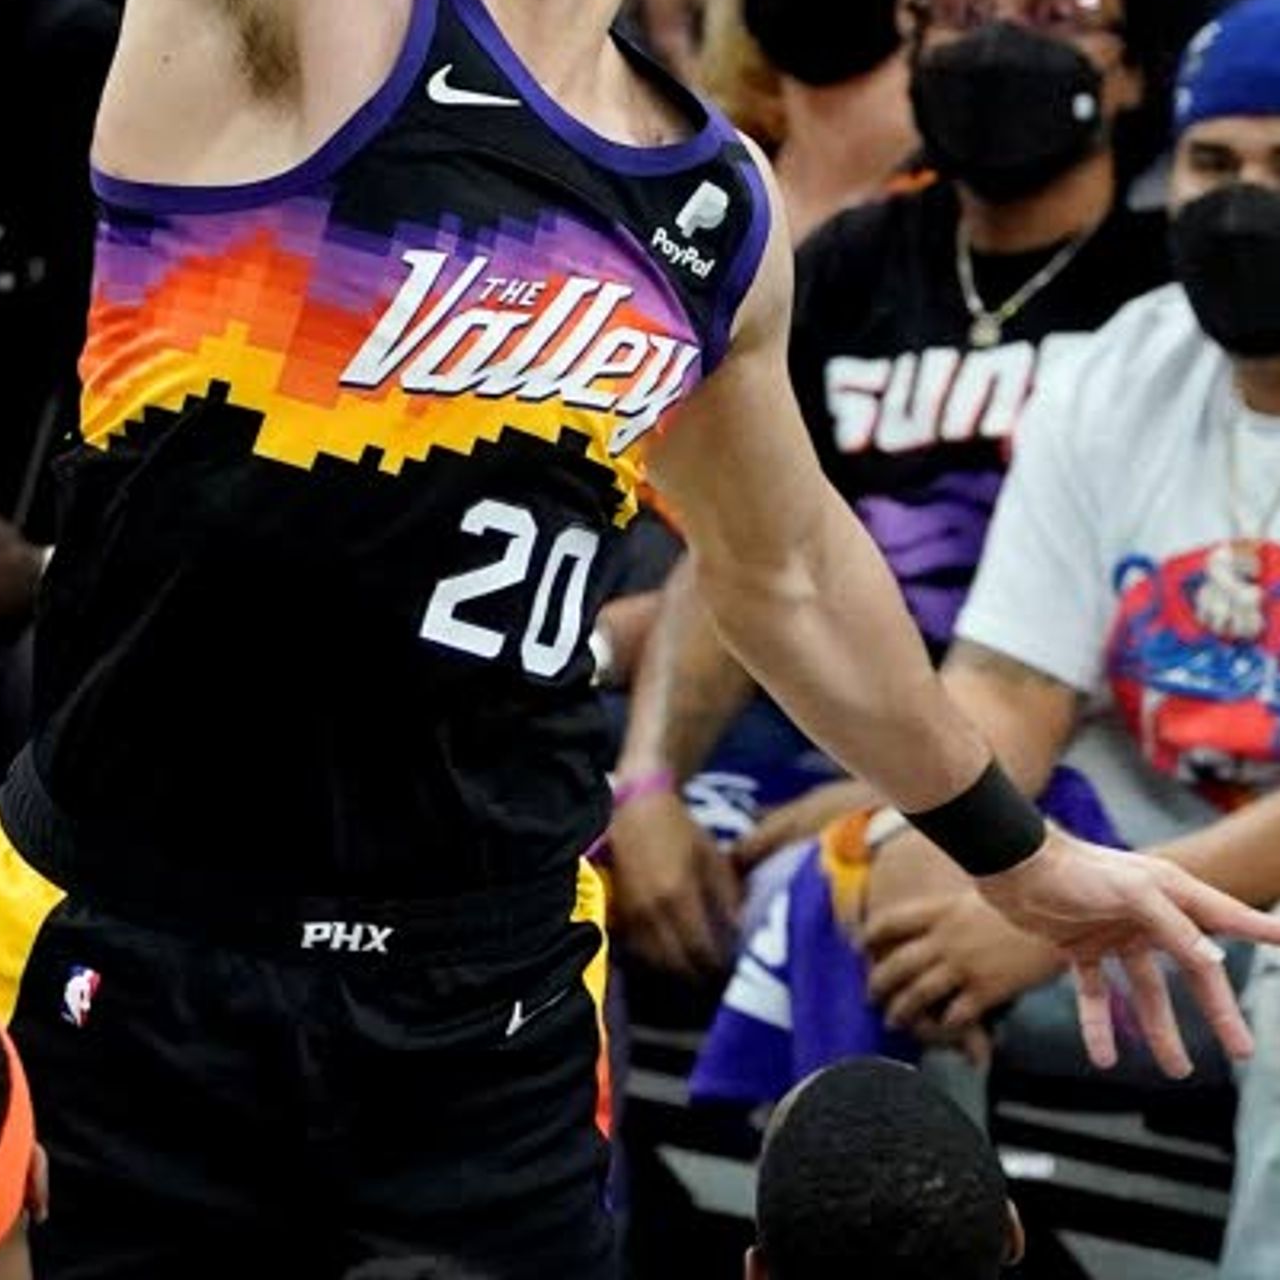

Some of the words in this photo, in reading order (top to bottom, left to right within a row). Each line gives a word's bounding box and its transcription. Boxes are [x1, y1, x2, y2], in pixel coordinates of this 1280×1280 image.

[651, 226, 716, 280] PayPal
[478, 276, 547, 307] THE
[339, 248, 702, 458] Valley
[418, 497, 601, 678] 20
[300, 920, 395, 955] PHX
